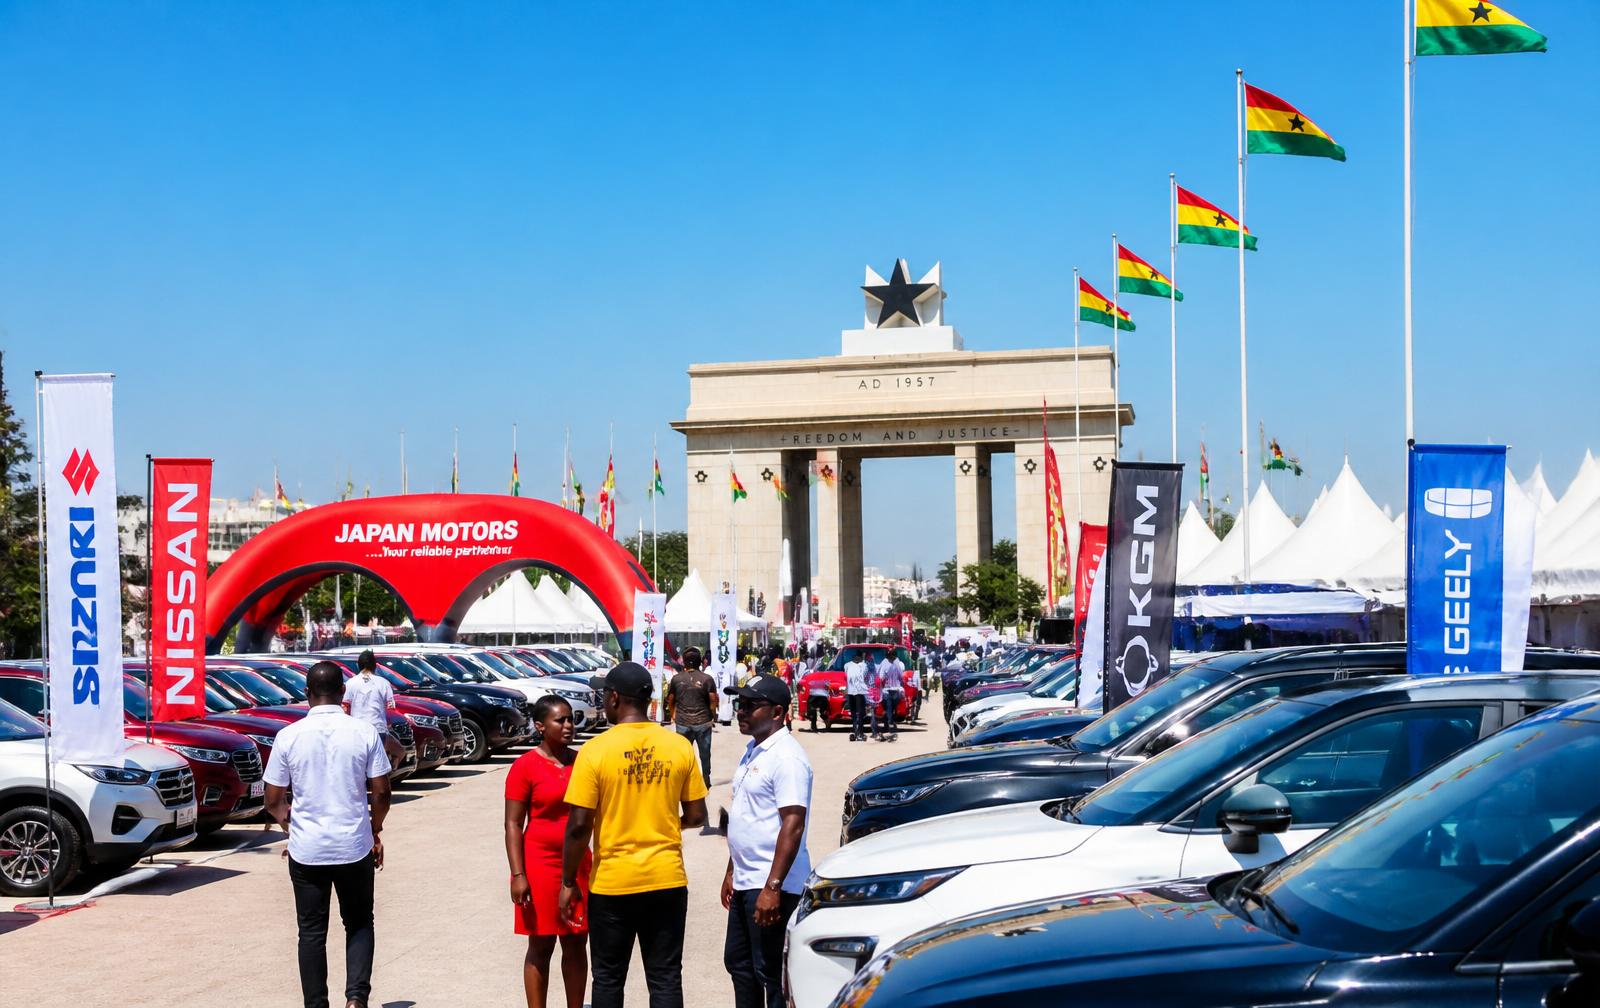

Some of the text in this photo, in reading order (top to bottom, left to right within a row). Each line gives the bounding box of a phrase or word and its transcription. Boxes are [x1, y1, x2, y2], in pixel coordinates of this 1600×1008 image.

[858, 376, 936, 390] AD 1957
[883, 430, 917, 441] AND
[335, 519, 519, 543] JAPAN MOTORS
[410, 545, 453, 557] reliable
[1127, 485, 1159, 627] KGM
[166, 482, 198, 705] NISSAN
[1444, 528, 1472, 655] GEELY
